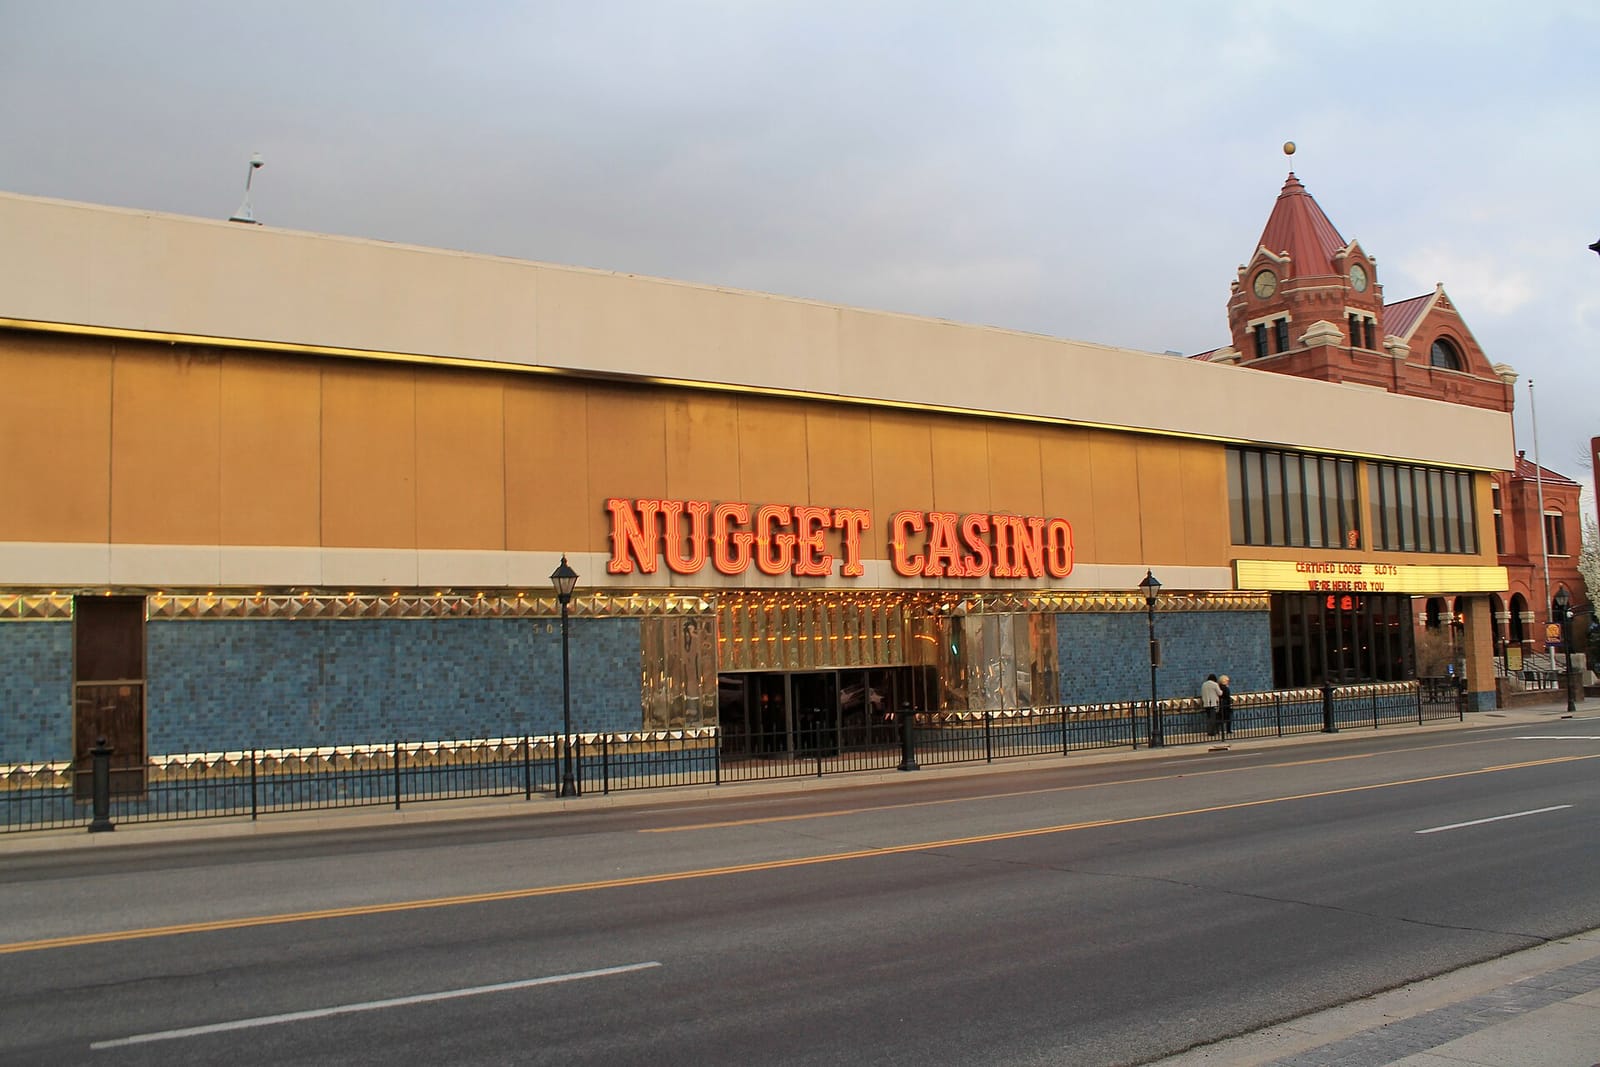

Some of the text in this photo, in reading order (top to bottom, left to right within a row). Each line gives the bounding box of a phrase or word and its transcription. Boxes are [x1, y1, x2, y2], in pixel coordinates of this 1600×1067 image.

[607, 497, 1075, 579] NUGGET CASINO
[1296, 562, 1397, 575] CERTIFIED LOOSE SLOTS
[1308, 580, 1384, 591] WE'RE HERE FOR YOU
[532, 623, 563, 634] 50
